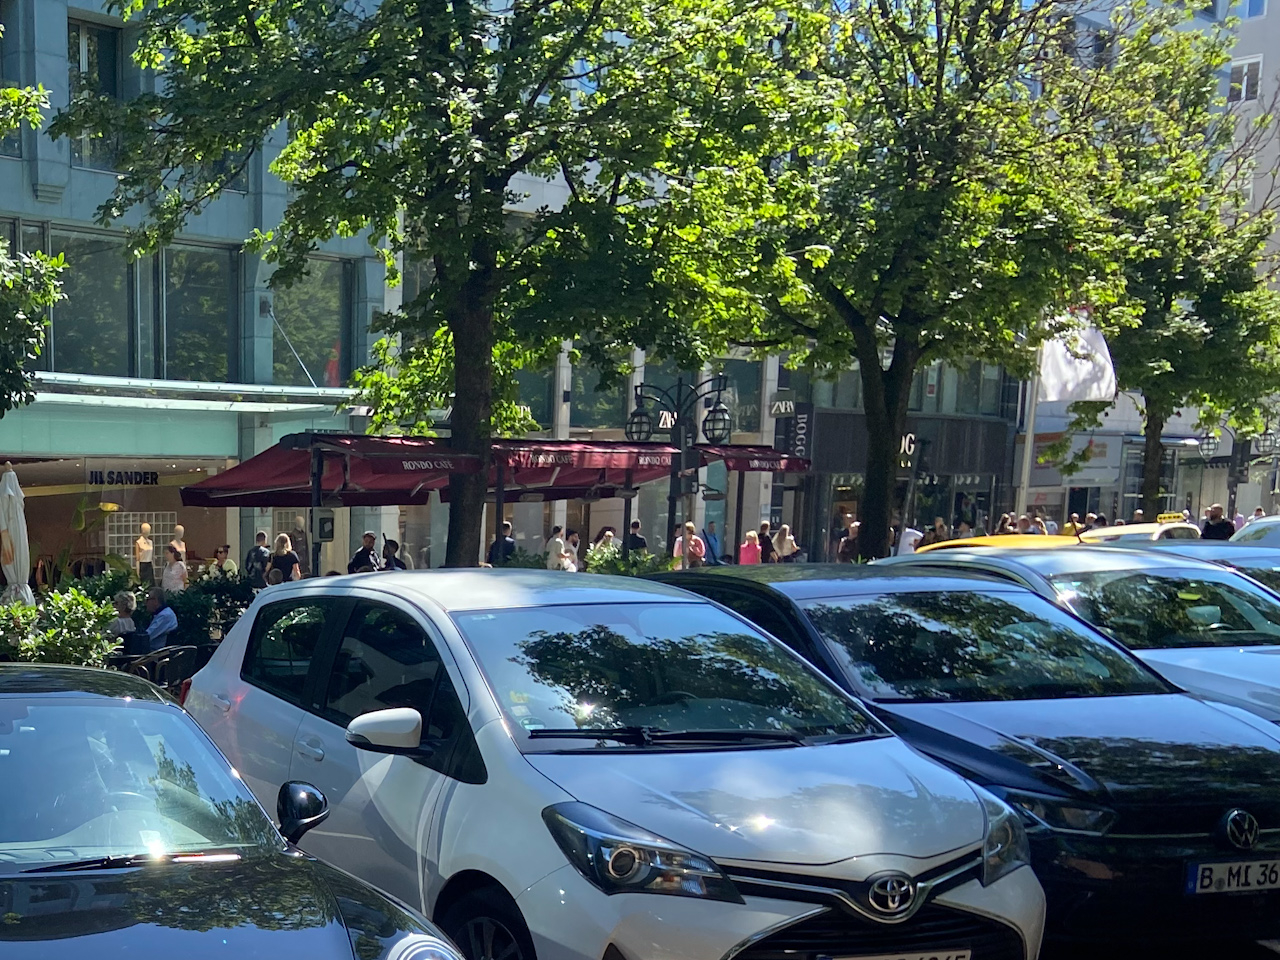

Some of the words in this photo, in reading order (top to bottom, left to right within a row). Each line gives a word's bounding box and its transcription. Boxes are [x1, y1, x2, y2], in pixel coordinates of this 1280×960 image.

[402, 460, 432, 470] RONDO
[88, 470, 105, 485] JIL
[107, 470, 159, 485] SANDER
[1199, 867, 1214, 889] B
[1227, 864, 1252, 887] MI
[1256, 863, 1279, 886] 36
